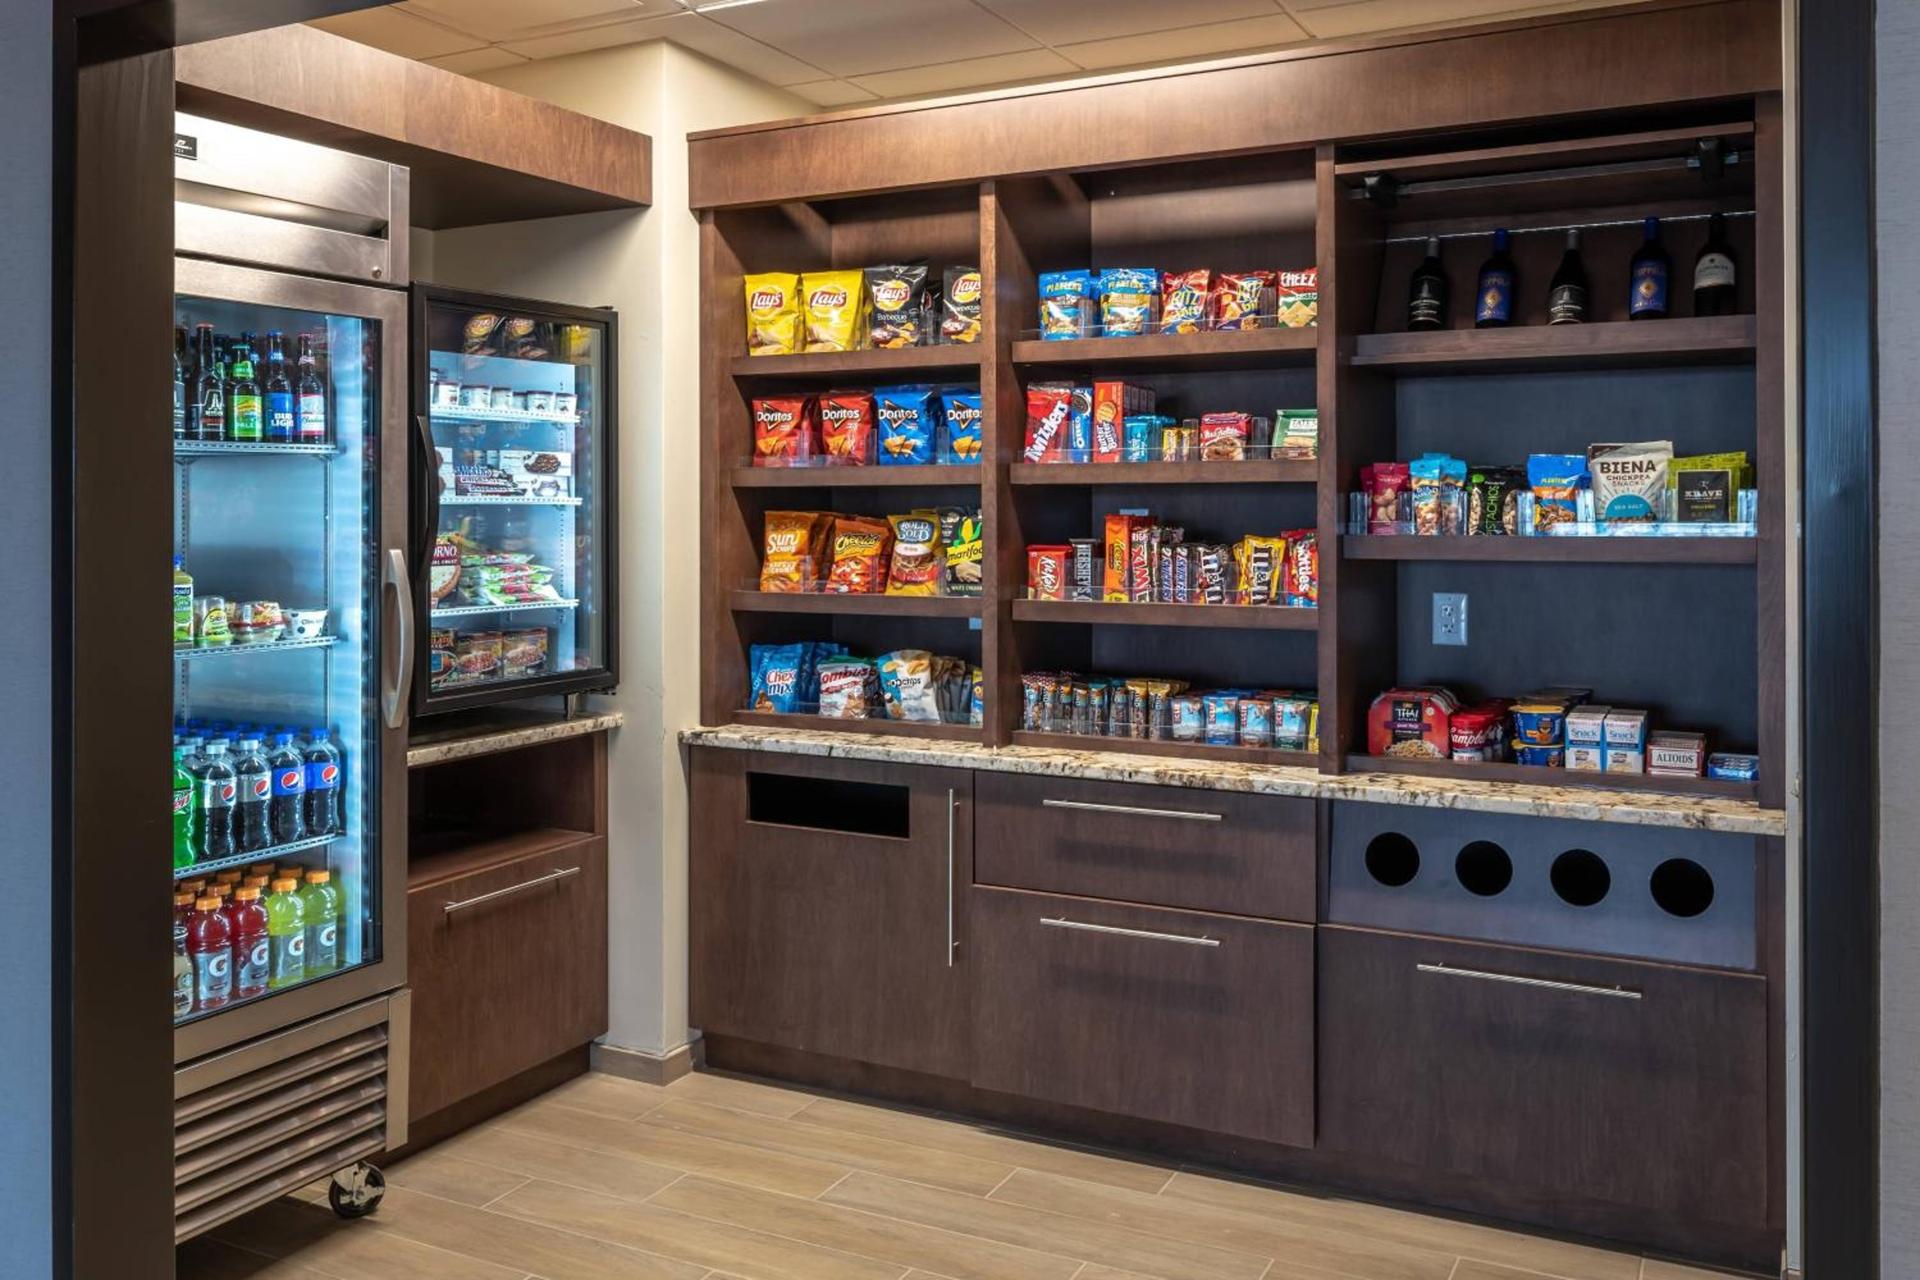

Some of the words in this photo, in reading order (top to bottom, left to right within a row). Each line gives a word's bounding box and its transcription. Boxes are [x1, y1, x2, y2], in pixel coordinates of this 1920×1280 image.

[752, 291, 782, 310] Lay's
[810, 290, 847, 307] Lay's
[757, 411, 793, 422] Doritos
[822, 408, 860, 420] Doritos
[878, 408, 918, 420] Doritos
[1600, 460, 1657, 474] BIENA
[767, 669, 798, 684] Chex
[821, 667, 869, 684] ombos
[767, 682, 794, 696] mix
[1394, 708, 1419, 718] THAI
[1571, 728, 1597, 738] Snack
[1610, 731, 1635, 740] Snack
[1656, 753, 1694, 764] ALTOIDS
[208, 955, 228, 977] G
